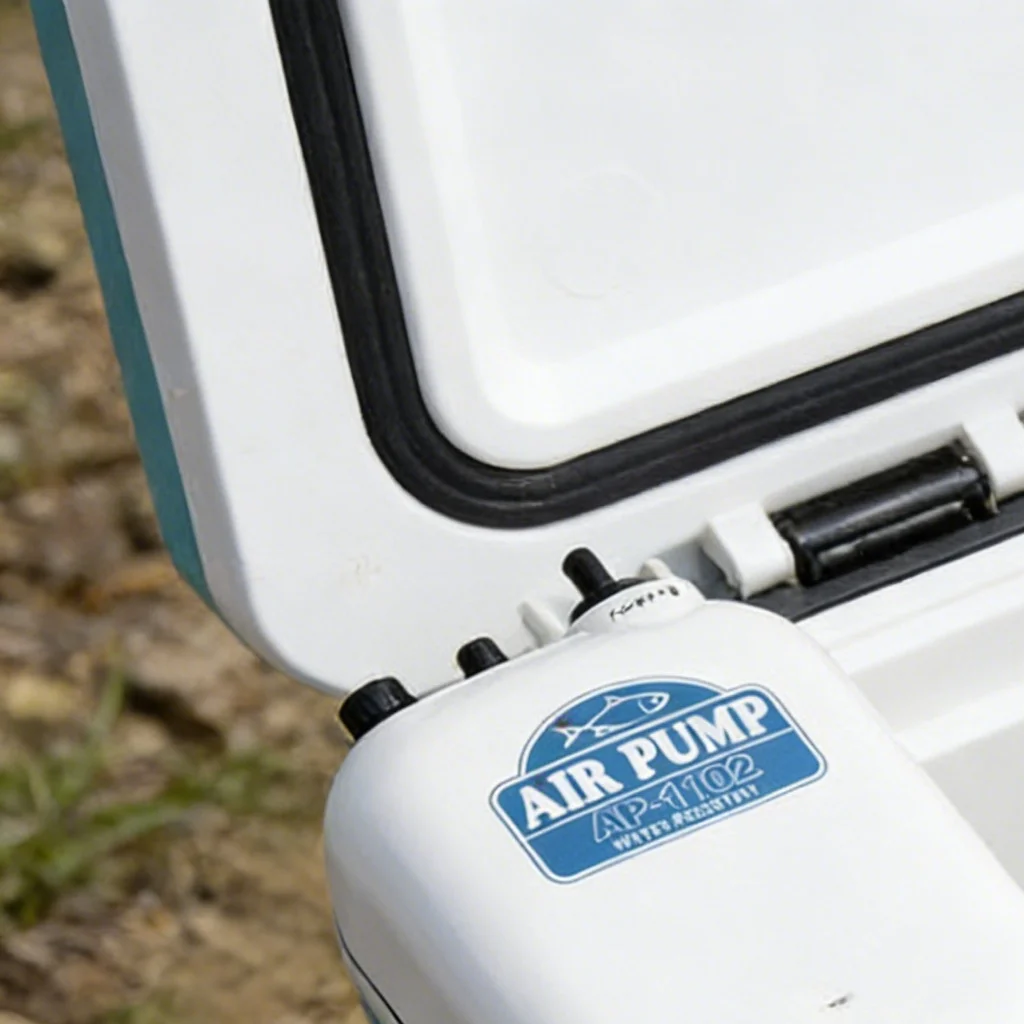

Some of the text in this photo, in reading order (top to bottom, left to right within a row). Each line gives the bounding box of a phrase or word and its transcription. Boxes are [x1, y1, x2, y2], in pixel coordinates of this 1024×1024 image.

[519, 759, 623, 830] AIR
[617, 695, 769, 780] PUMP
[592, 753, 764, 843] AP-1102
